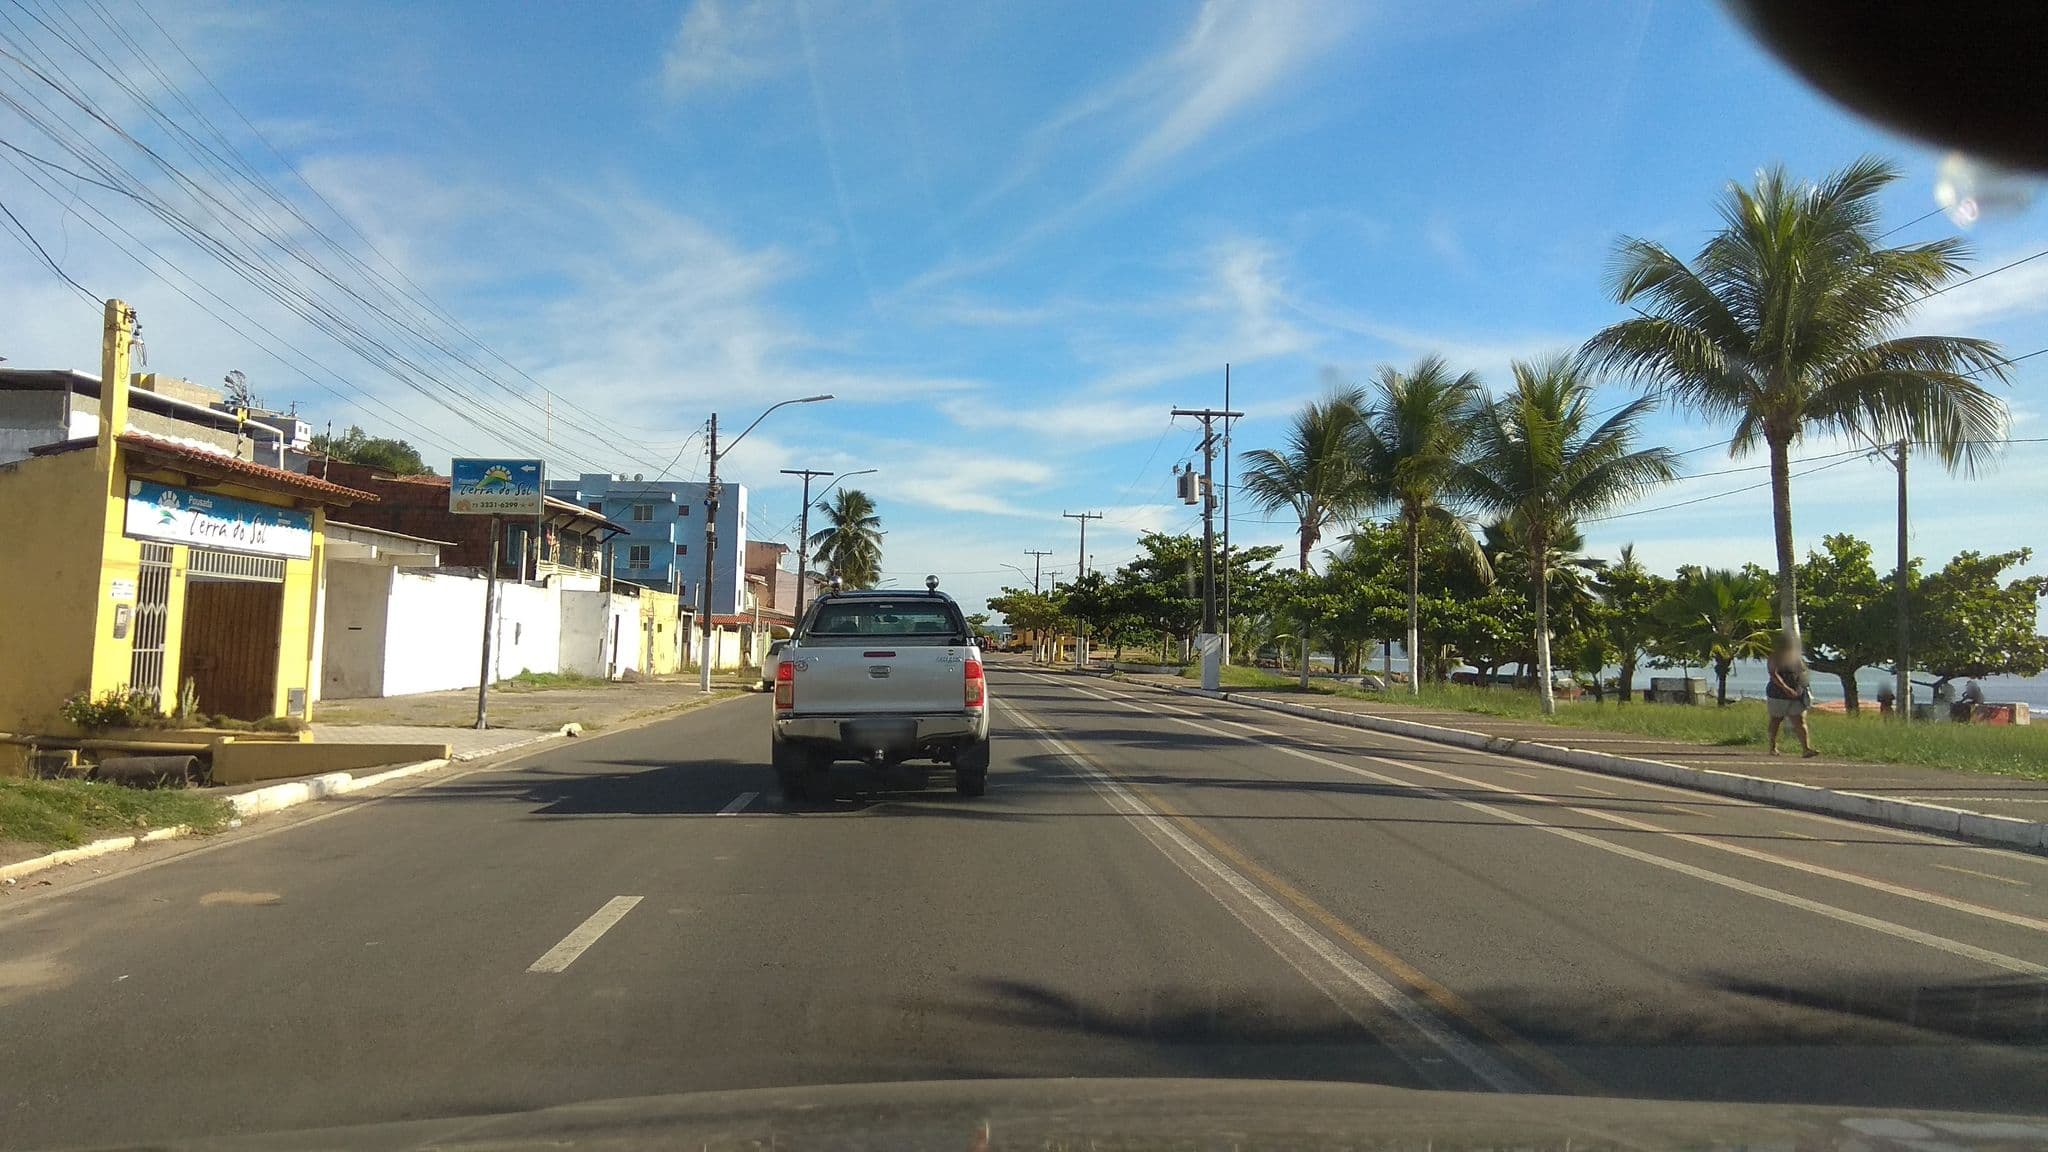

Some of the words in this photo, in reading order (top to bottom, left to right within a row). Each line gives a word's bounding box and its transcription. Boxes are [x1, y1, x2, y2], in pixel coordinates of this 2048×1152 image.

[459, 483, 495, 496] Terra
[499, 481, 511, 495] do
[515, 482, 533, 496] Sol
[188, 494, 214, 509] Pousada
[188, 508, 228, 537] Terra
[232, 513, 245, 541] do
[249, 513, 268, 544] Sol
